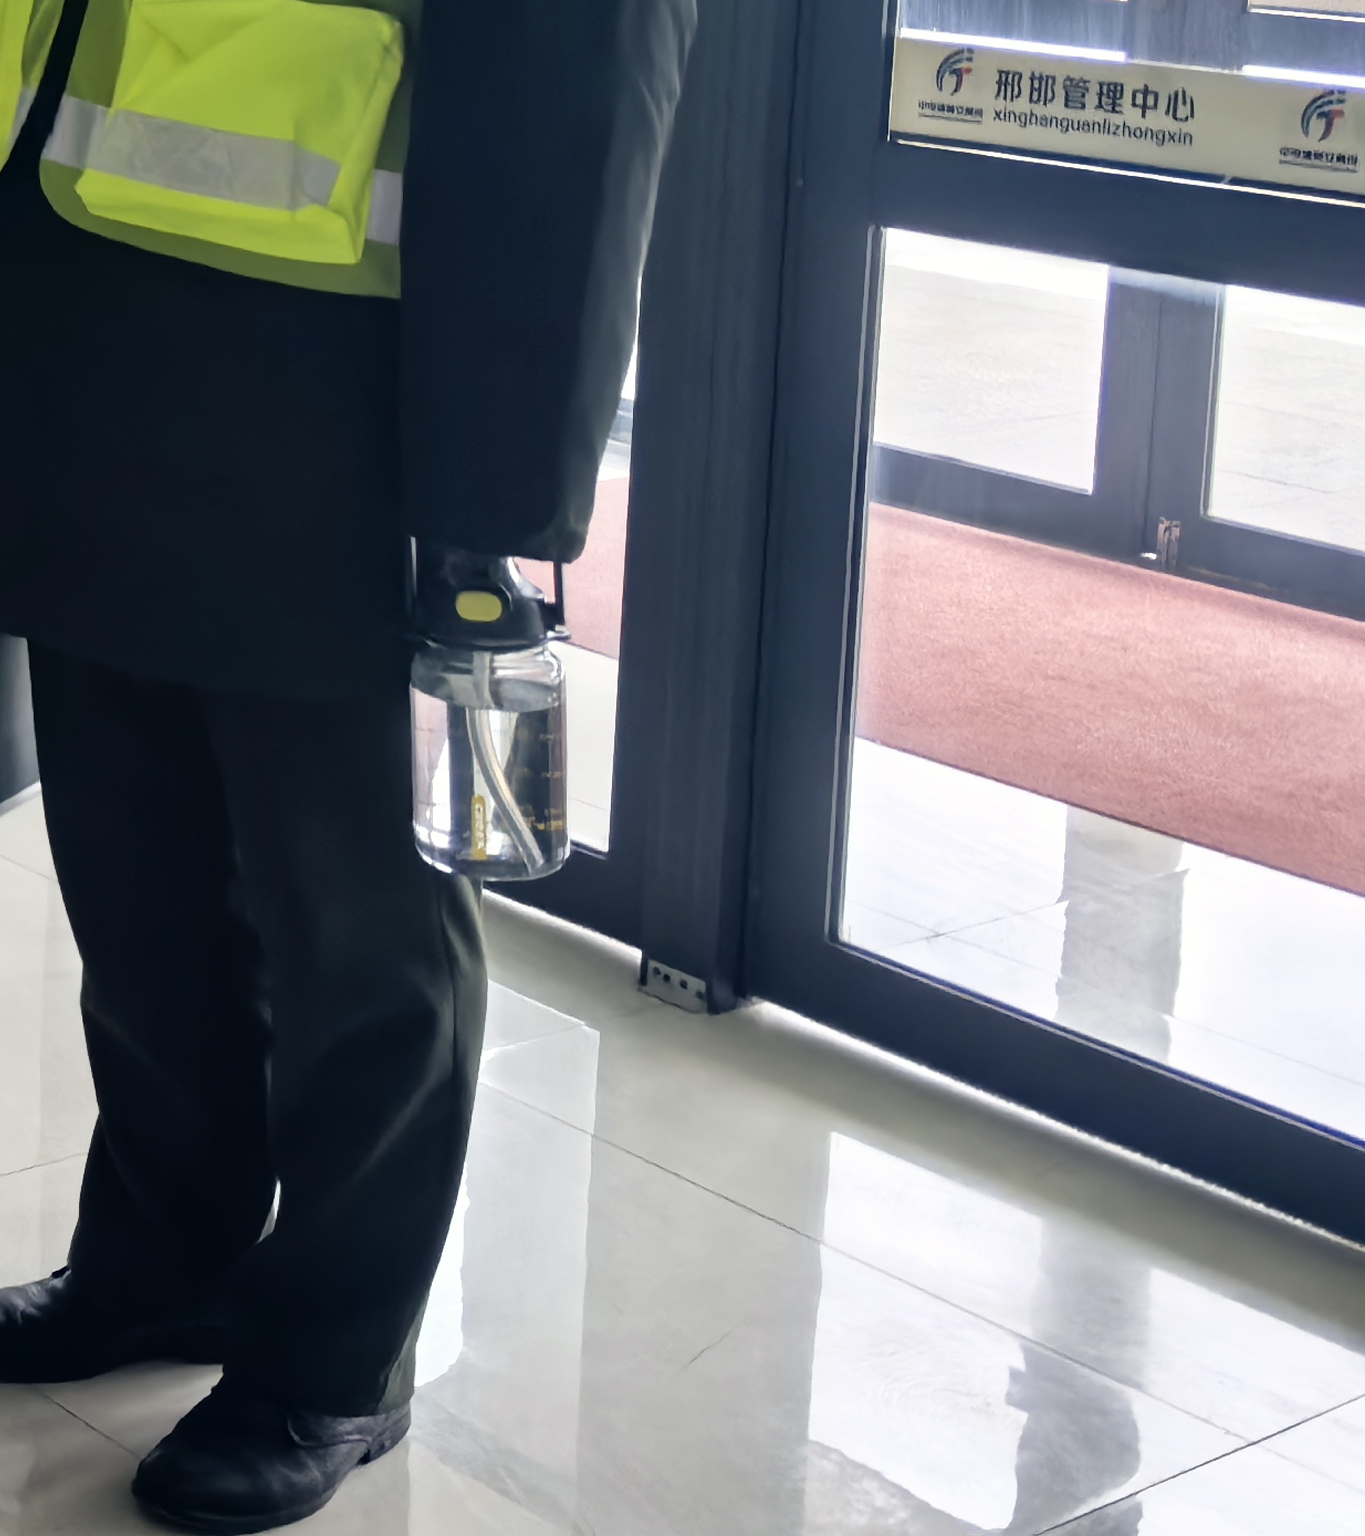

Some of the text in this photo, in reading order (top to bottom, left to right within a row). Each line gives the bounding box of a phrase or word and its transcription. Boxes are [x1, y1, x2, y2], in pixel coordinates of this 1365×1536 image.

[994, 68, 1195, 123] 邢邯管理中心
[993, 105, 1193, 147] xinghanguanlizhongxin
